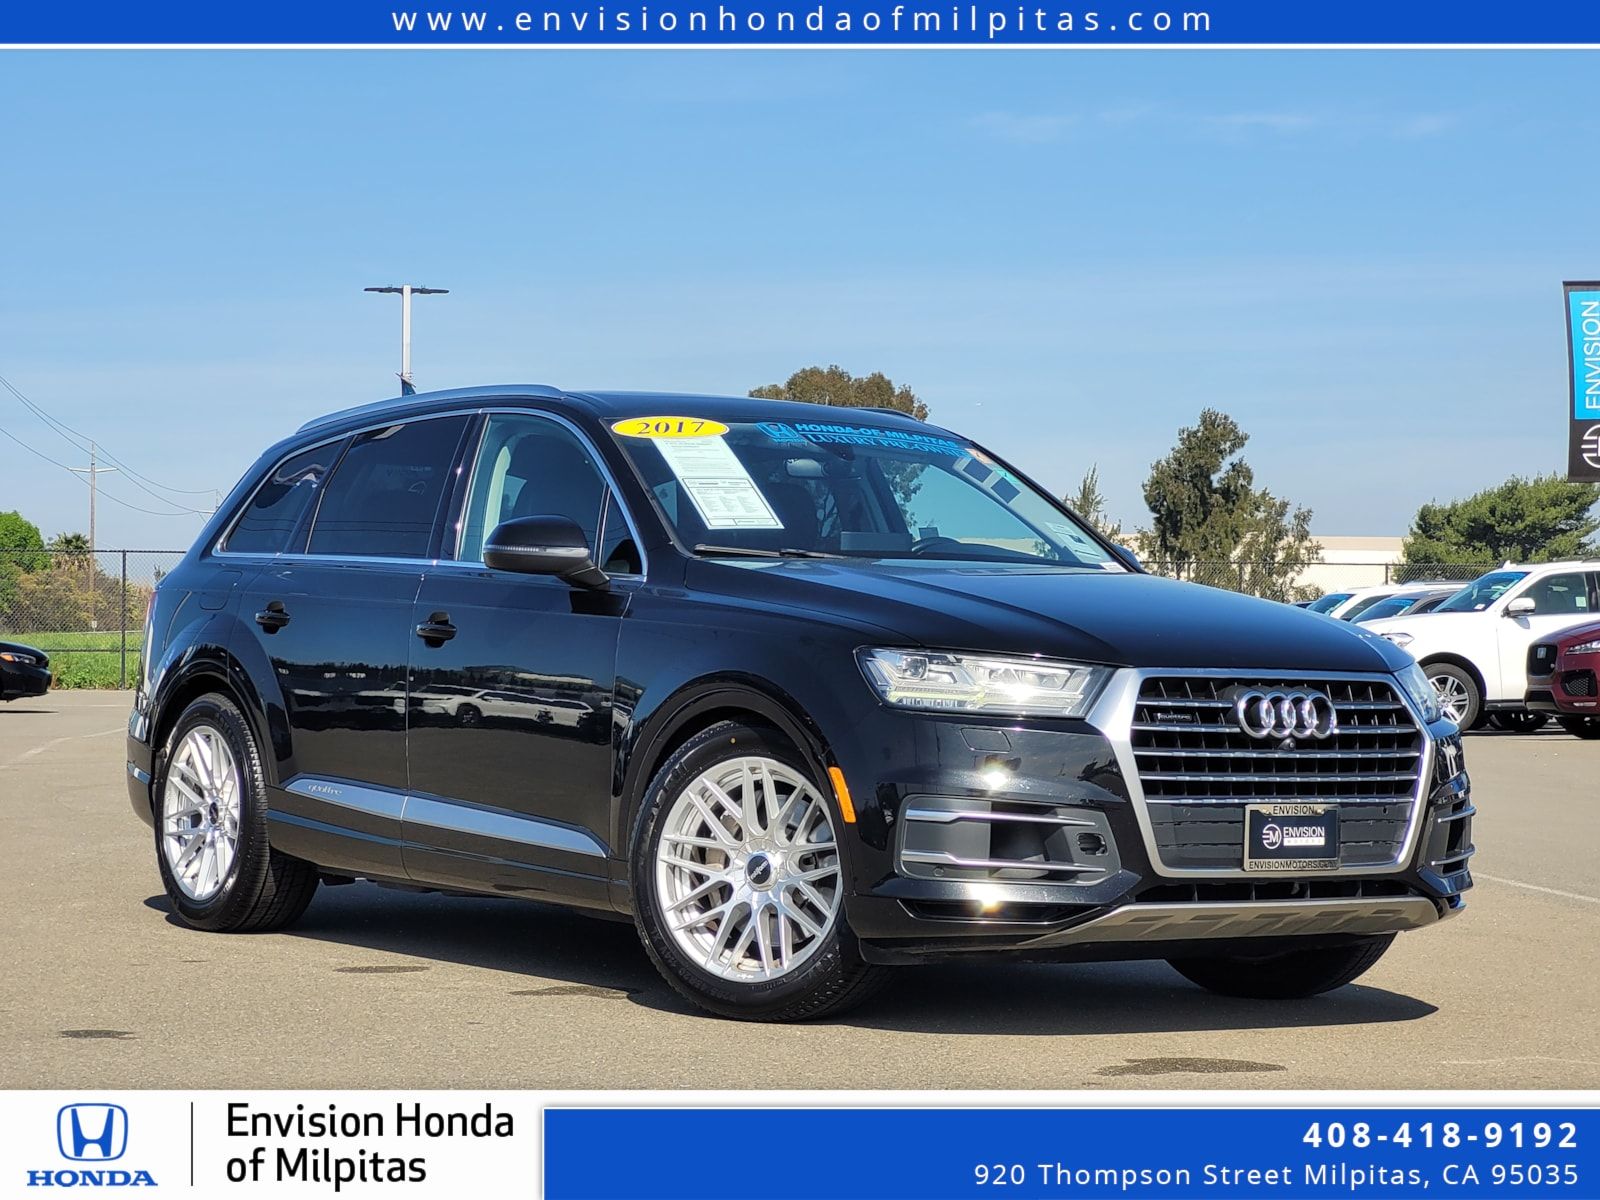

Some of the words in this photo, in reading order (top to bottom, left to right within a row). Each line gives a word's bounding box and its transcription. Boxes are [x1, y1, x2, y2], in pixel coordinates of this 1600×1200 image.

[1581, 300, 1600, 409] ENVISION
[636, 421, 705, 435] 2017
[795, 423, 857, 434] HONDA
[884, 430, 960, 448] MILPITAS
[807, 434, 877, 446] LUXURY
[1273, 805, 1315, 815] ENVISION
[1283, 826, 1325, 838] ENVISION
